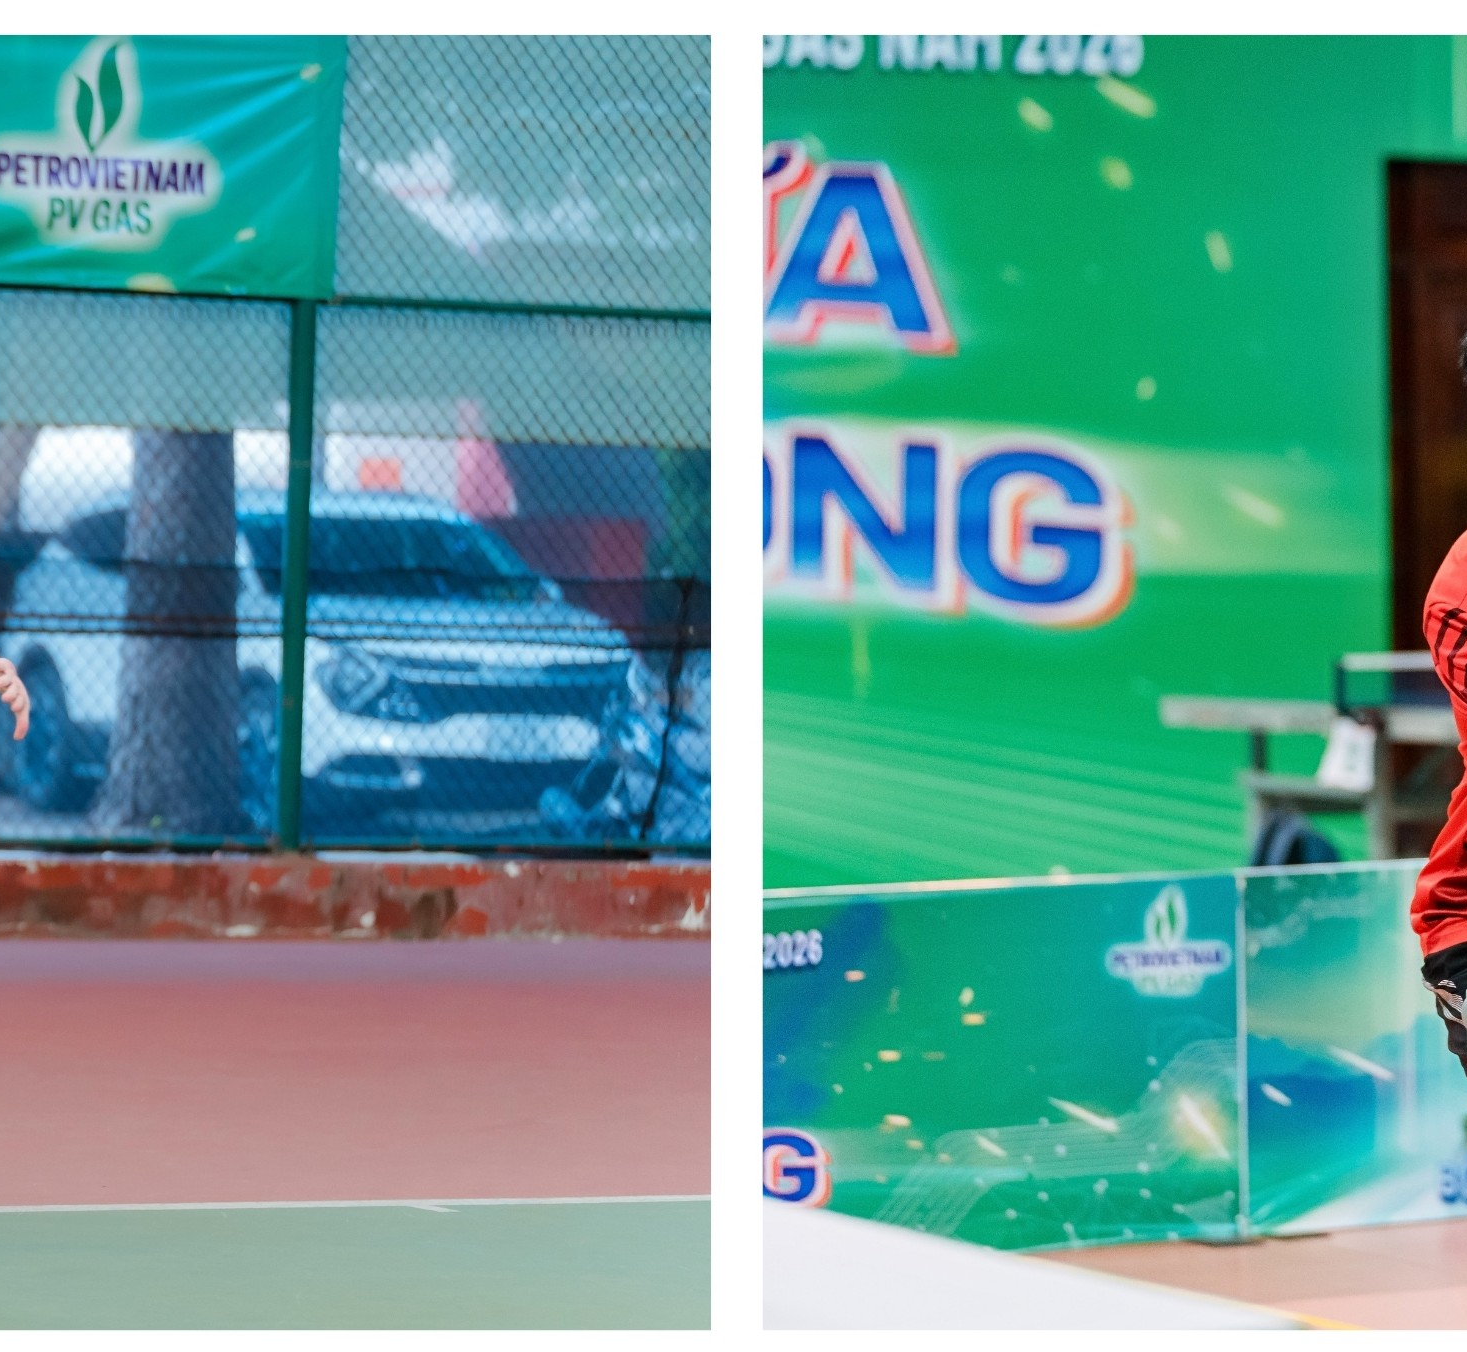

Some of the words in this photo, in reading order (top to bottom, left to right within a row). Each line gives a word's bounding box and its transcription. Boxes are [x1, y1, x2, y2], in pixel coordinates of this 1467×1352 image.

[46, 197, 88, 231] PV
[91, 199, 153, 235] GAS
[763, 929, 823, 969] 2026
